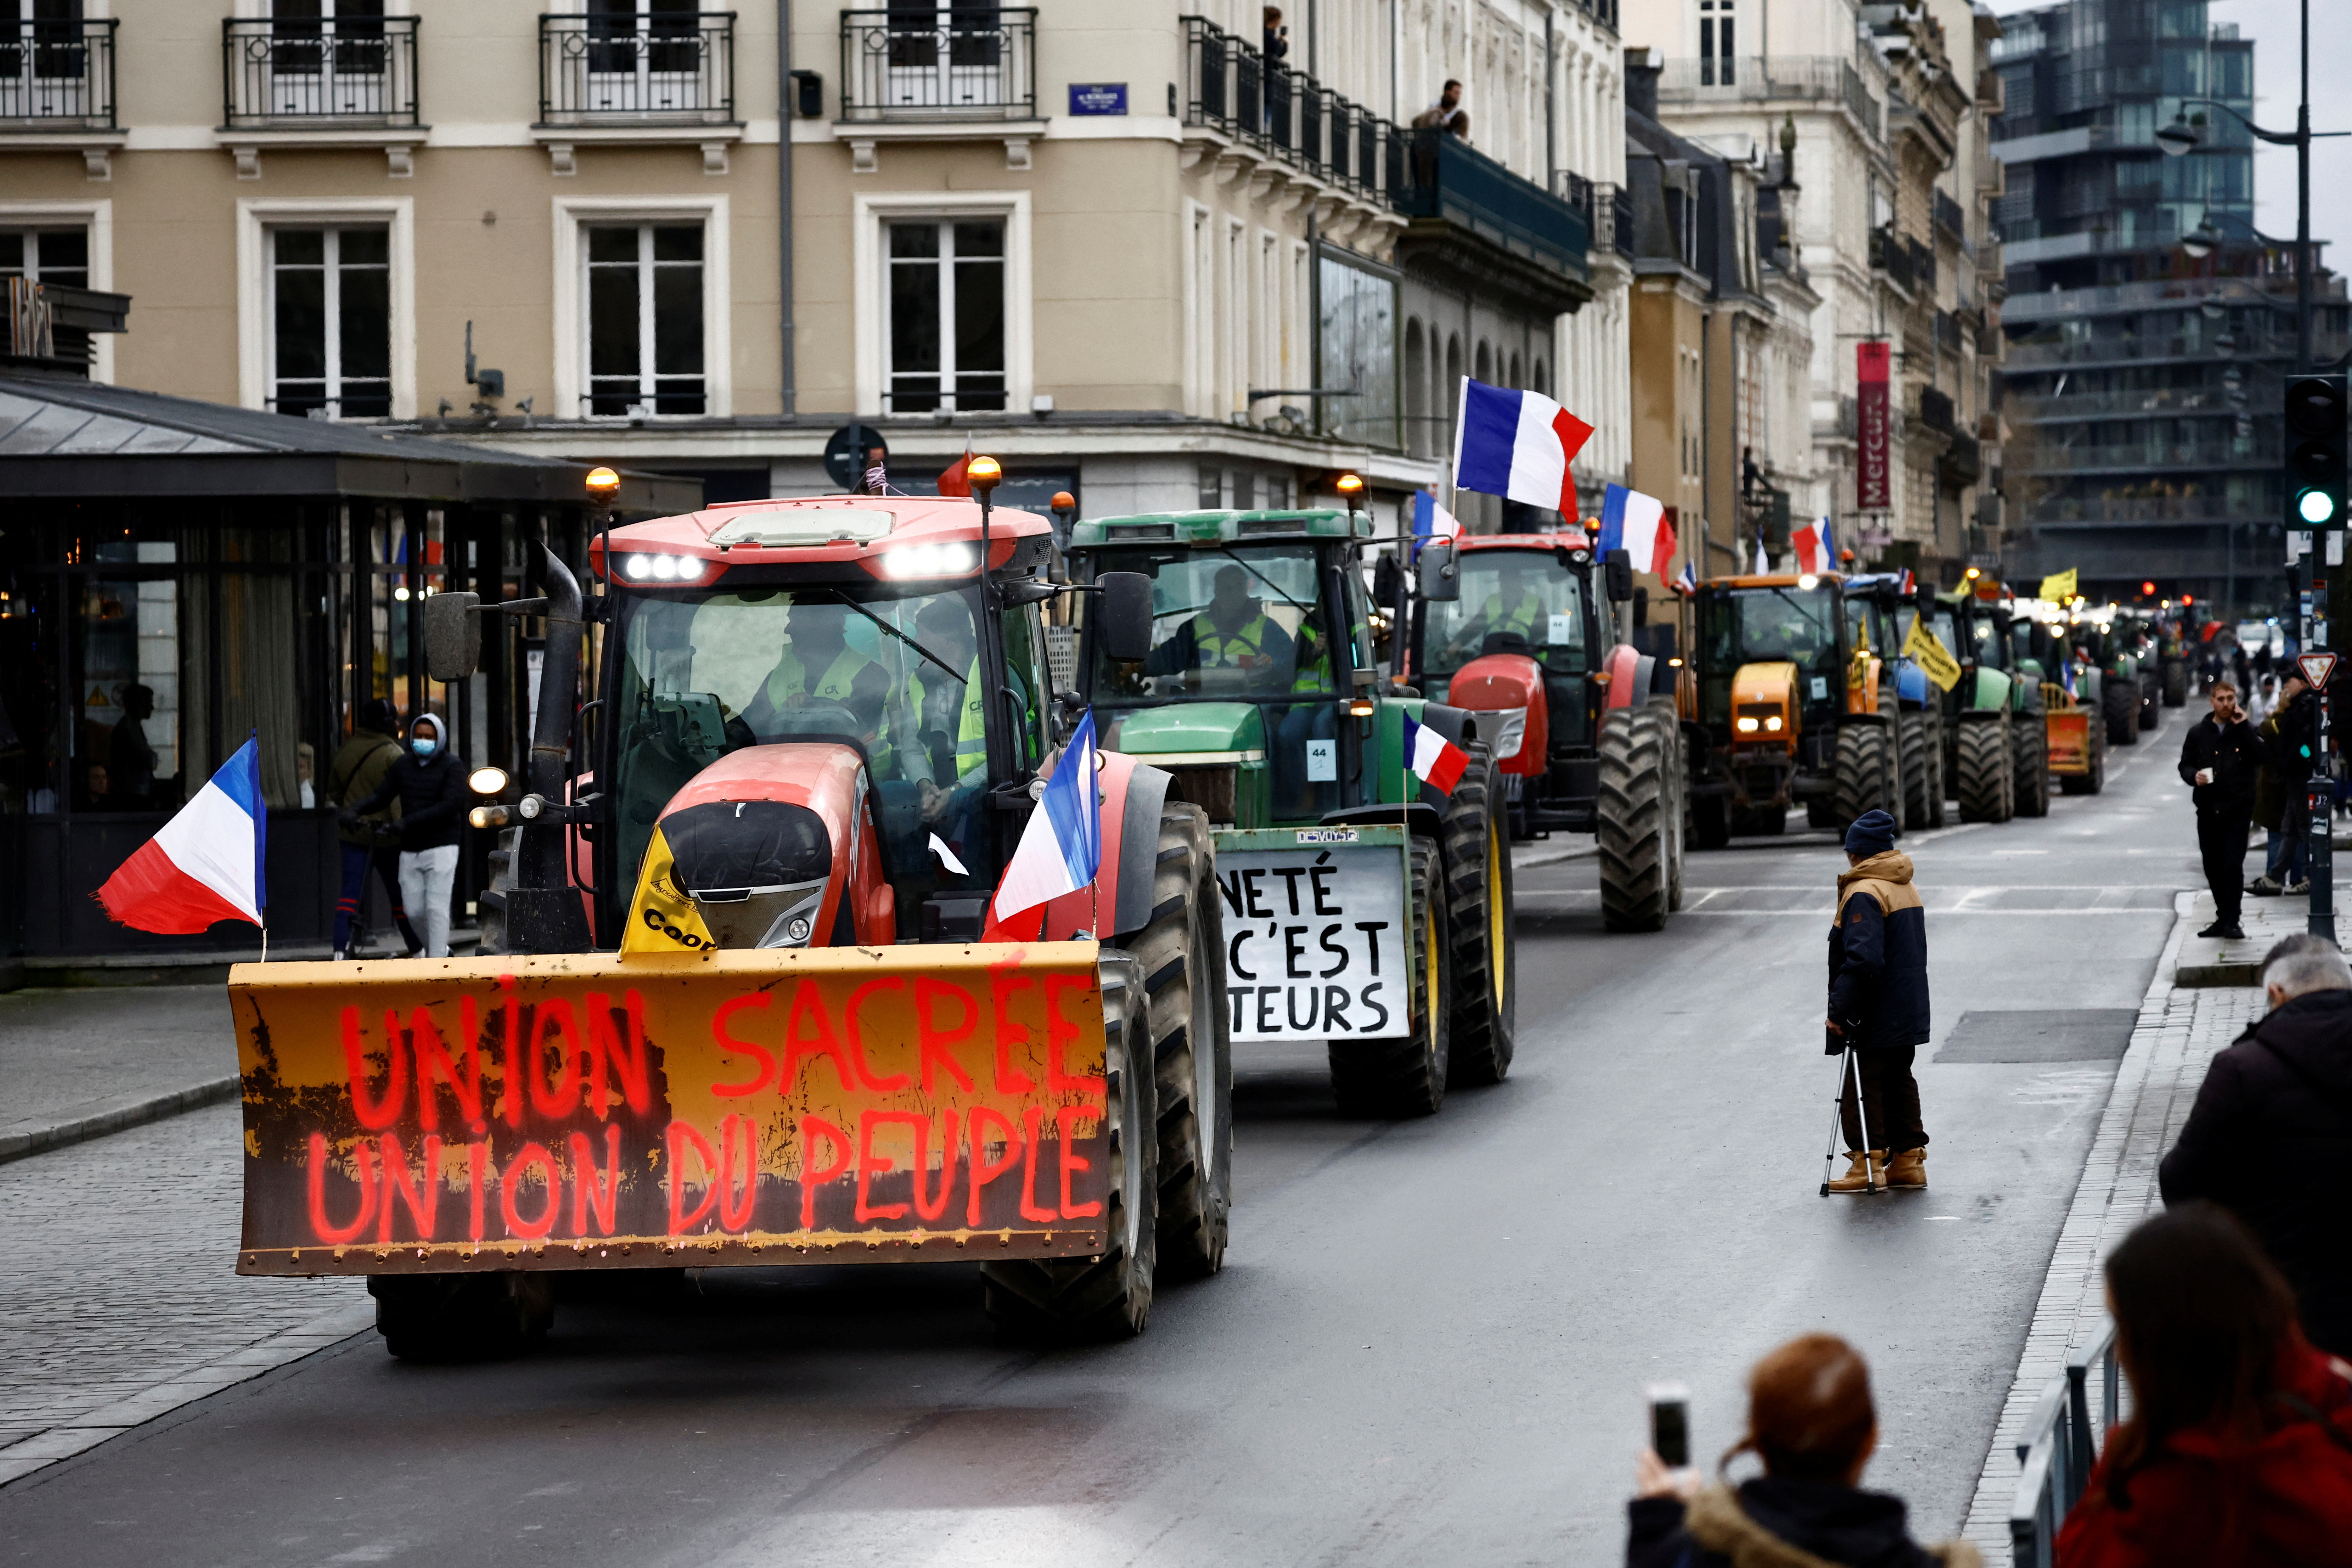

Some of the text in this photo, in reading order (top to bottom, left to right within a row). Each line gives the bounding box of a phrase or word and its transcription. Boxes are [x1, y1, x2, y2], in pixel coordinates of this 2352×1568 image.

[1866, 390, 1883, 504] Mercure
[655, 882, 691, 908] Agriculteurs
[1230, 922, 1388, 981] C'EST
[711, 950, 1105, 1097] SACRÉE
[1228, 982, 1388, 1032] TEURS
[307, 1104, 1102, 1245] UNION DU PEUPLE
